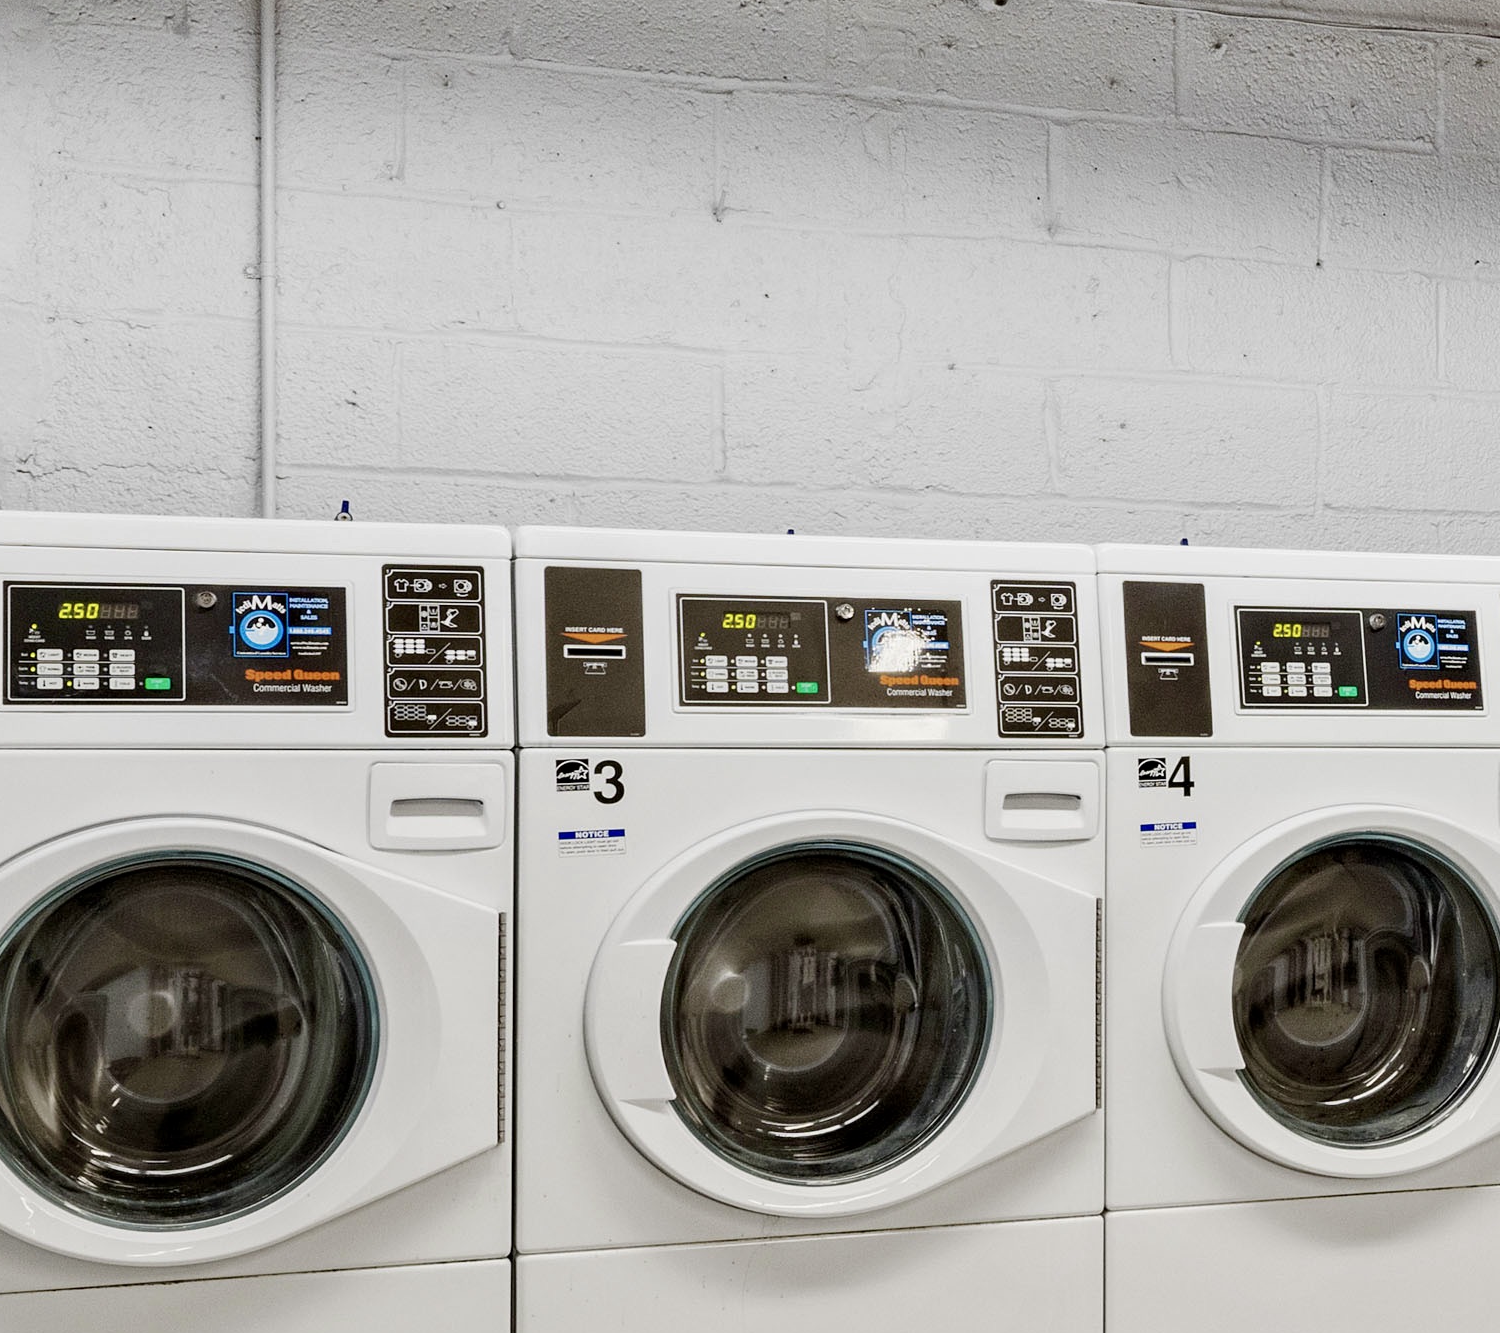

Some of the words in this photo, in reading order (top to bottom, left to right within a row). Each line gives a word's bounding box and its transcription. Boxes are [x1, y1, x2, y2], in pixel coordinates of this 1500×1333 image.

[58, 603, 99, 619] 2.50
[721, 613, 757, 629] 2.50
[1272, 623, 1302, 638] 2.50
[245, 668, 292, 682] Speed
[293, 668, 341, 681] Queen
[880, 674, 919, 687] Speed
[920, 674, 960, 686] Queen
[252, 683, 301, 693] Commercial
[302, 683, 332, 693] Washer
[886, 688, 927, 696] Commercial
[928, 688, 953, 697] Washer
[593, 759, 625, 804] 3
[1168, 756, 1195, 797] 4
[1153, 823, 1183, 831] NOTICE
[574, 831, 610, 839] NOTICE
